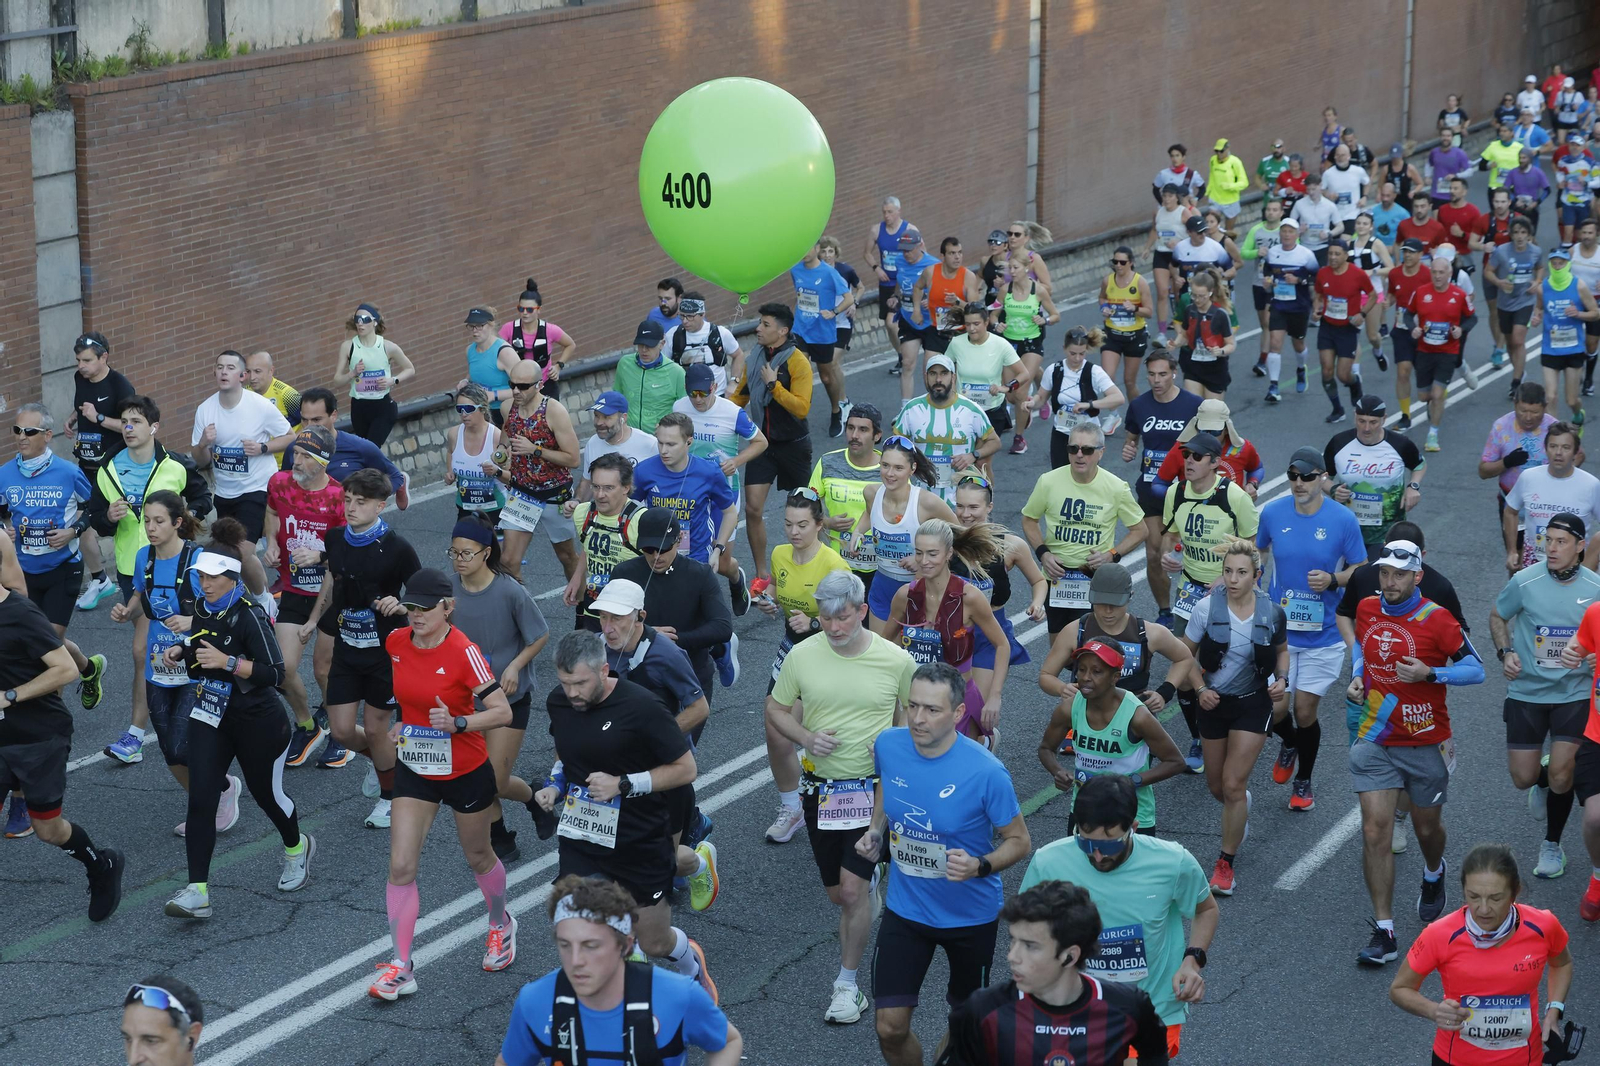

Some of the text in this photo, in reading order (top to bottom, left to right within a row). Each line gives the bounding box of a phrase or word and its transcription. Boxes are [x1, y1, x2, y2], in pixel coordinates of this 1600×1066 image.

[661, 171, 712, 209] 4:00
[363, 384, 378, 392] JADE
[1154, 419, 1185, 431] asics
[217, 462, 245, 472] TONY OG
[25, 490, 63, 499] AUTISMO
[25, 499, 58, 507] SEVILLA
[651, 495, 696, 510] BRUMMEN 2
[1529, 502, 1580, 515] CUATRECASAS
[503, 505, 537, 525] MIGUEL ANGEL
[1060, 497, 1086, 522] 40
[1529, 510, 1549, 519] Sports
[1184, 512, 1205, 538] 40
[23, 536, 50, 546] ENRIQU
[882, 533, 906, 541] ZURICH
[1054, 525, 1102, 546] HUBERT
[587, 531, 611, 557] 40
[1056, 590, 1087, 600] HUBERT
[1295, 592, 1321, 600] ZURICH
[789, 597, 810, 607] GROGA
[1295, 603, 1309, 611] 7164
[1290, 611, 1313, 621] BREX
[357, 631, 378, 639] DAVID
[206, 680, 229, 692] ZURICH
[201, 699, 221, 716] PAULA
[1401, 702, 1433, 716] RUN
[1403, 711, 1434, 725] NING
[1403, 718, 1434, 734] Team
[414, 728, 444, 737] ZURICH
[402, 750, 448, 763] MARTINA
[1075, 752, 1113, 766] Compton
[837, 797, 854, 805] 8152
[580, 806, 600, 818] 12824
[818, 806, 874, 819] FREDNOTET
[560, 813, 616, 836] PACER PAUL
[906, 828, 939, 841] ZURICH
[906, 843, 927, 855] 11499
[897, 849, 939, 869] BARTEK
[1109, 957, 1147, 970] OJEDA
[1512, 960, 1540, 972] 42.195
[1484, 997, 1522, 1006] ZURICH
[1483, 1015, 1509, 1024] 12007
[1035, 1024, 1087, 1036] GIVOVA
[1468, 1026, 1523, 1039] CLAUDIE
